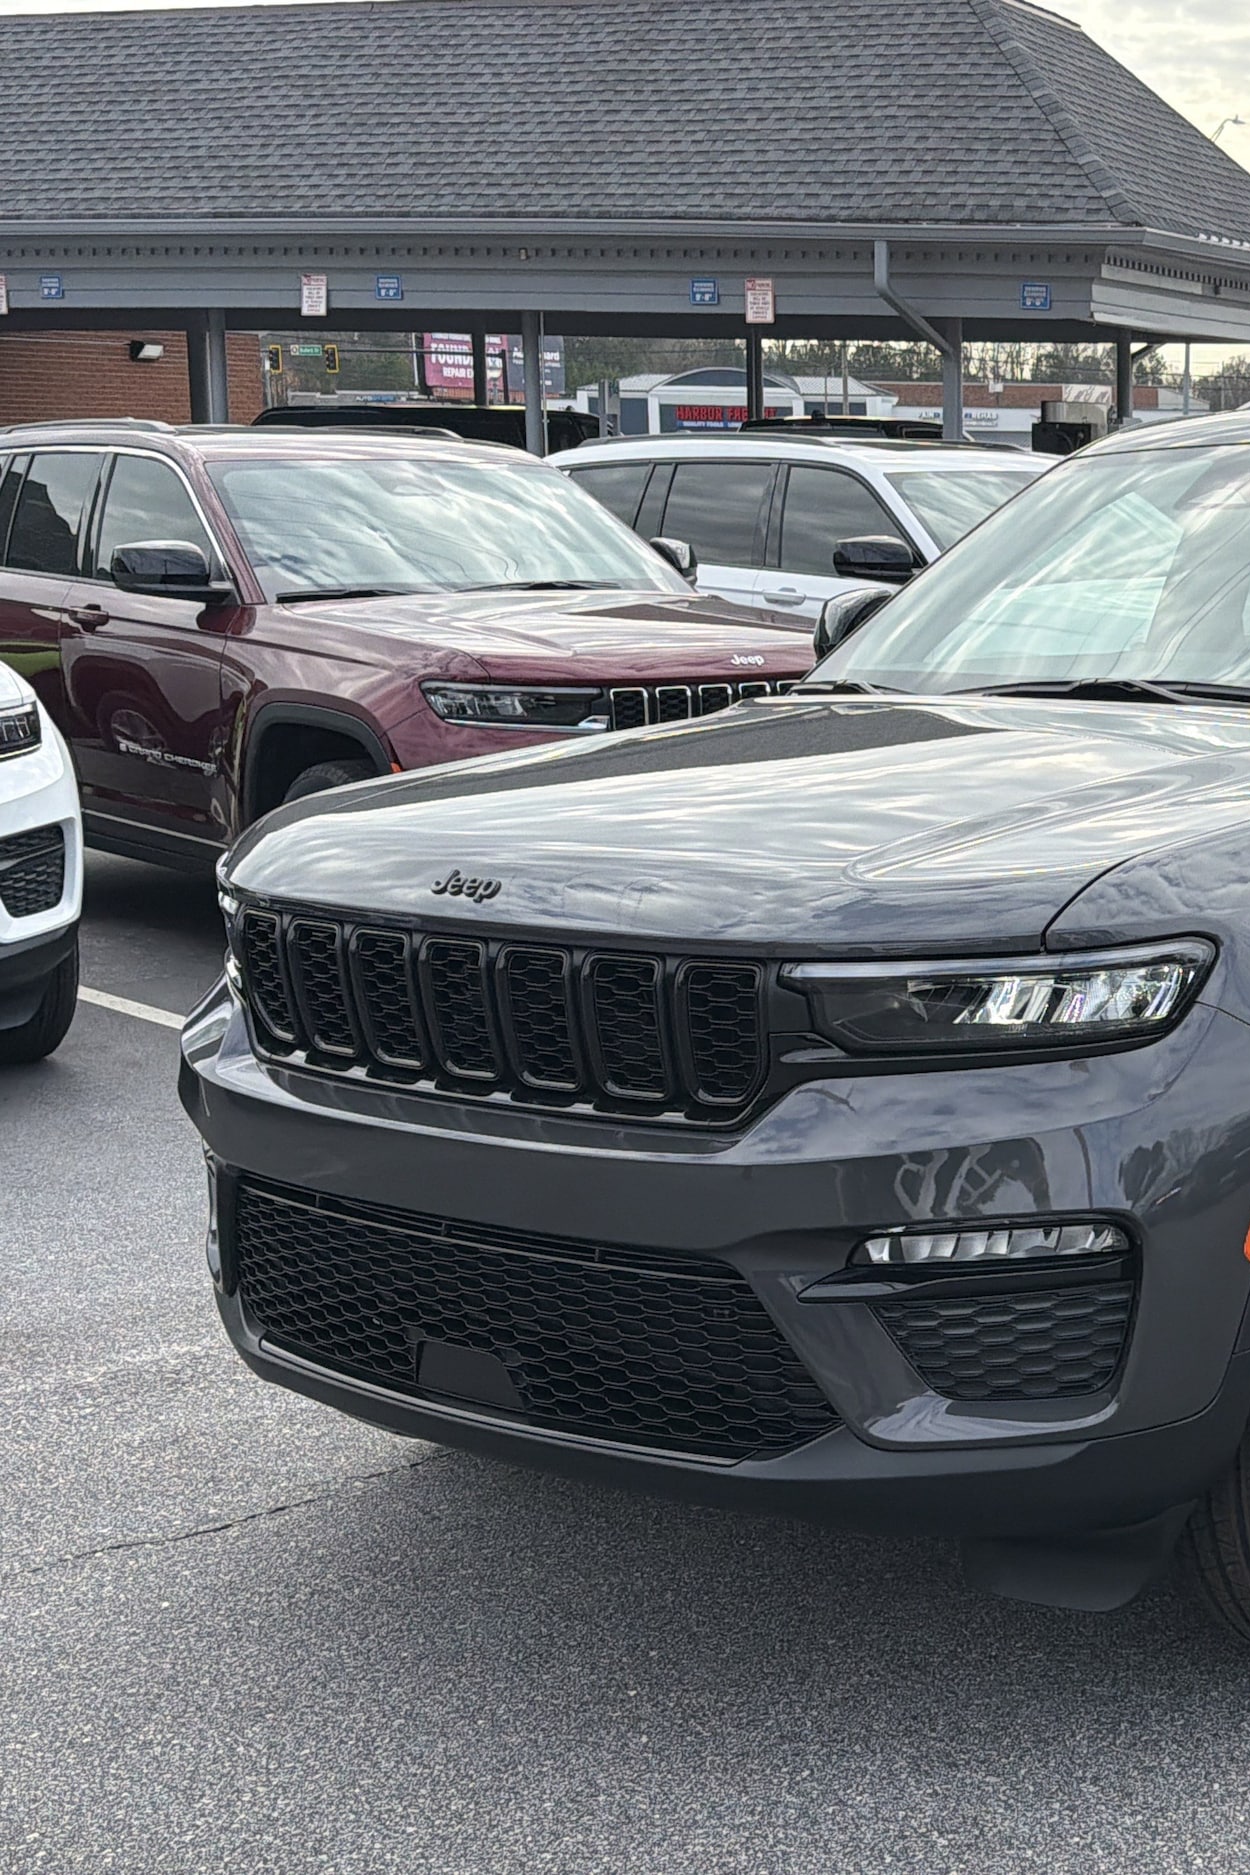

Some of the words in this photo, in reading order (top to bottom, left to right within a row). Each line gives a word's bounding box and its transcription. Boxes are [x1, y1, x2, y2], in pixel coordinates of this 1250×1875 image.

[676, 406, 723, 421] HARBOR
[730, 654, 765, 666] Jeep
[430, 869, 502, 904] Jeep
